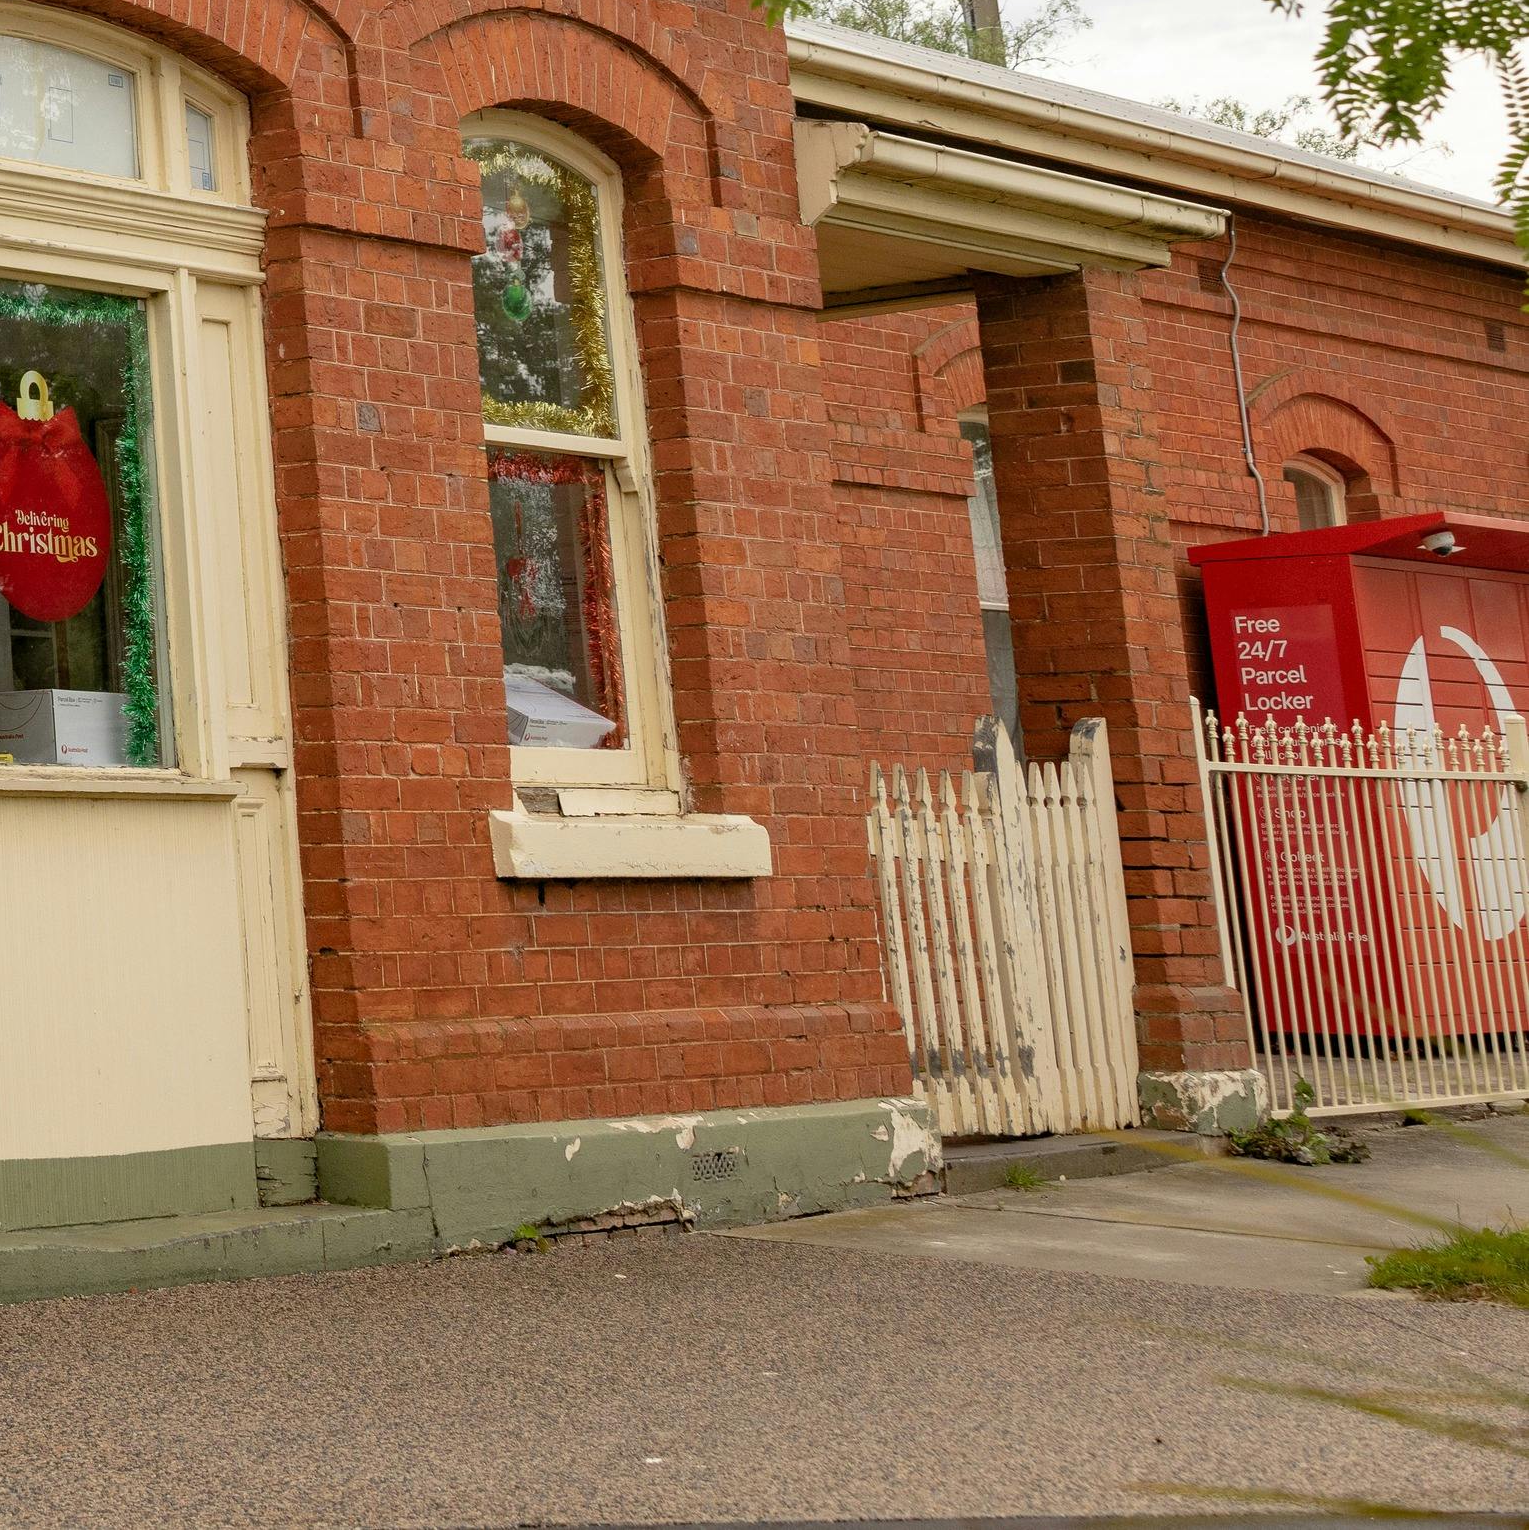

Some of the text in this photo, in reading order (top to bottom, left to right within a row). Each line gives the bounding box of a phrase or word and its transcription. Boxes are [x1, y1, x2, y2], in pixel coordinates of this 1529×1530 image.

[15, 509, 69, 532] Delivering
[1234, 616, 1280, 634] Free
[1237, 639, 1288, 662] 24/7
[1241, 664, 1307, 685] Parcel
[1244, 691, 1314, 711] Locker
[1280, 850, 1325, 863] Colect
[1300, 931, 1369, 942] Austali Pos
